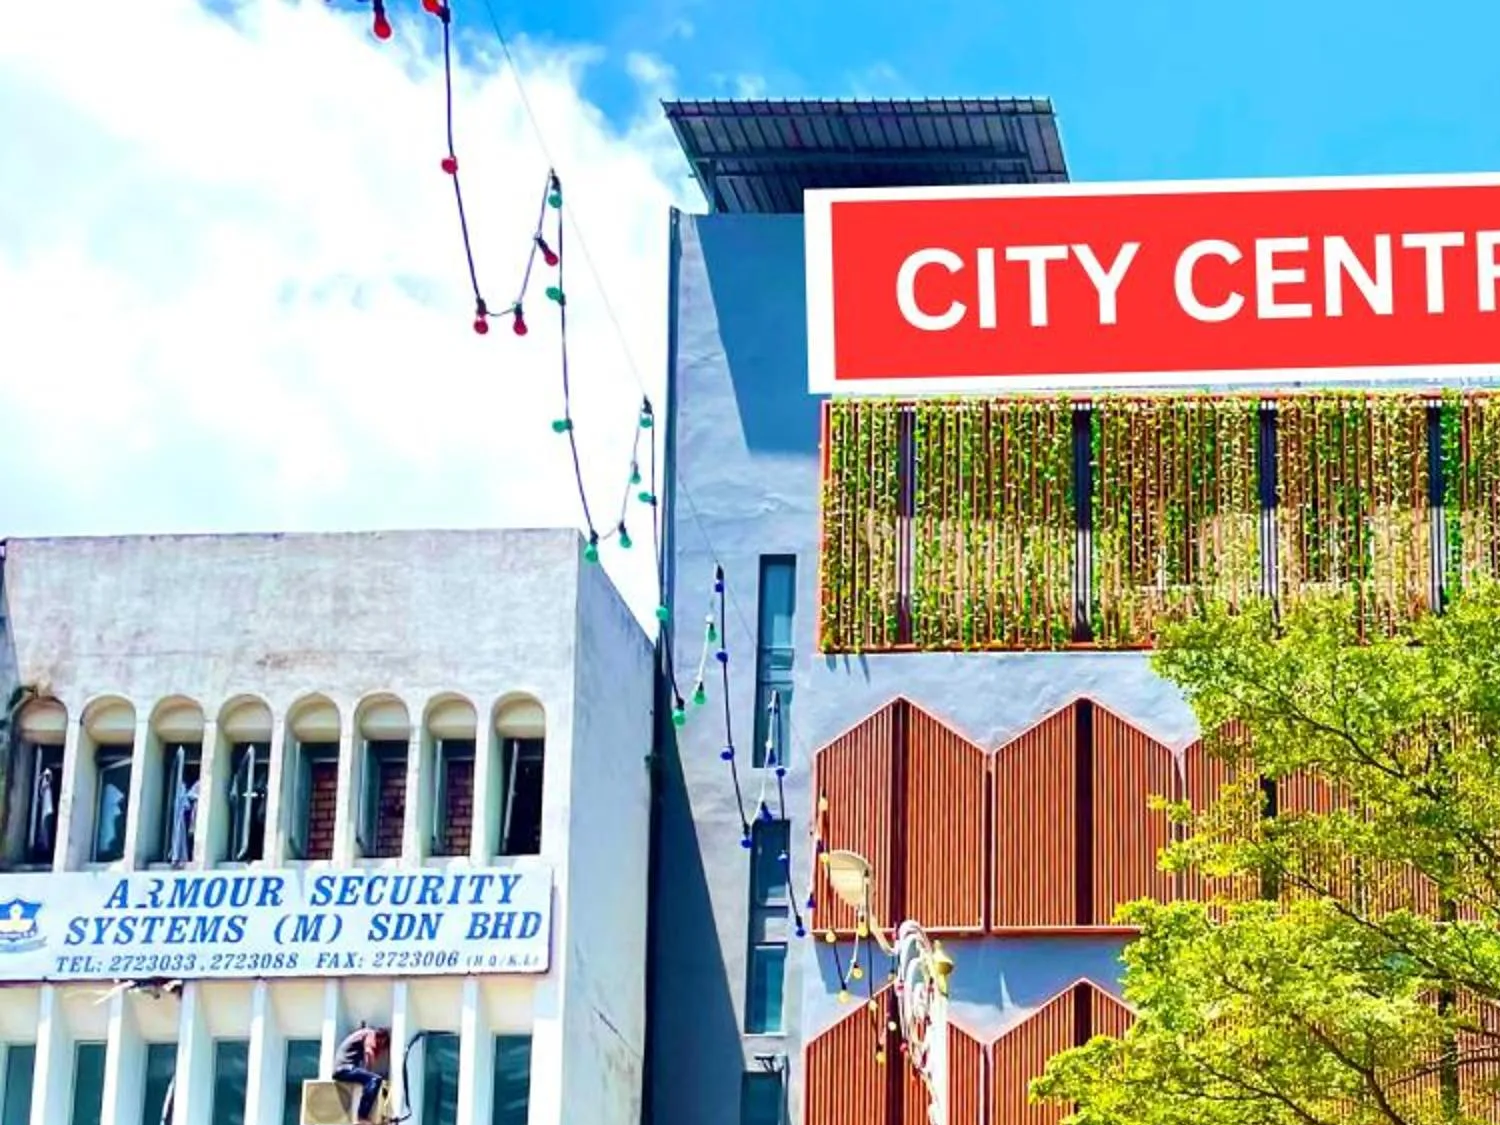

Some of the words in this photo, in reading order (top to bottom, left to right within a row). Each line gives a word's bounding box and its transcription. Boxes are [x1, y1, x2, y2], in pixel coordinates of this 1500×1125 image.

[894, 240, 1140, 332] CITY
[104, 876, 285, 909] ARMOUR
[310, 873, 522, 906] SECURITY
[64, 914, 248, 945] SYSTEMS
[273, 913, 343, 945] (M)
[368, 911, 444, 942] SDN
[465, 910, 542, 940] BHD
[56, 955, 102, 973] TEL:
[316, 951, 364, 969] FAX:
[371, 949, 459, 968] 2723006
